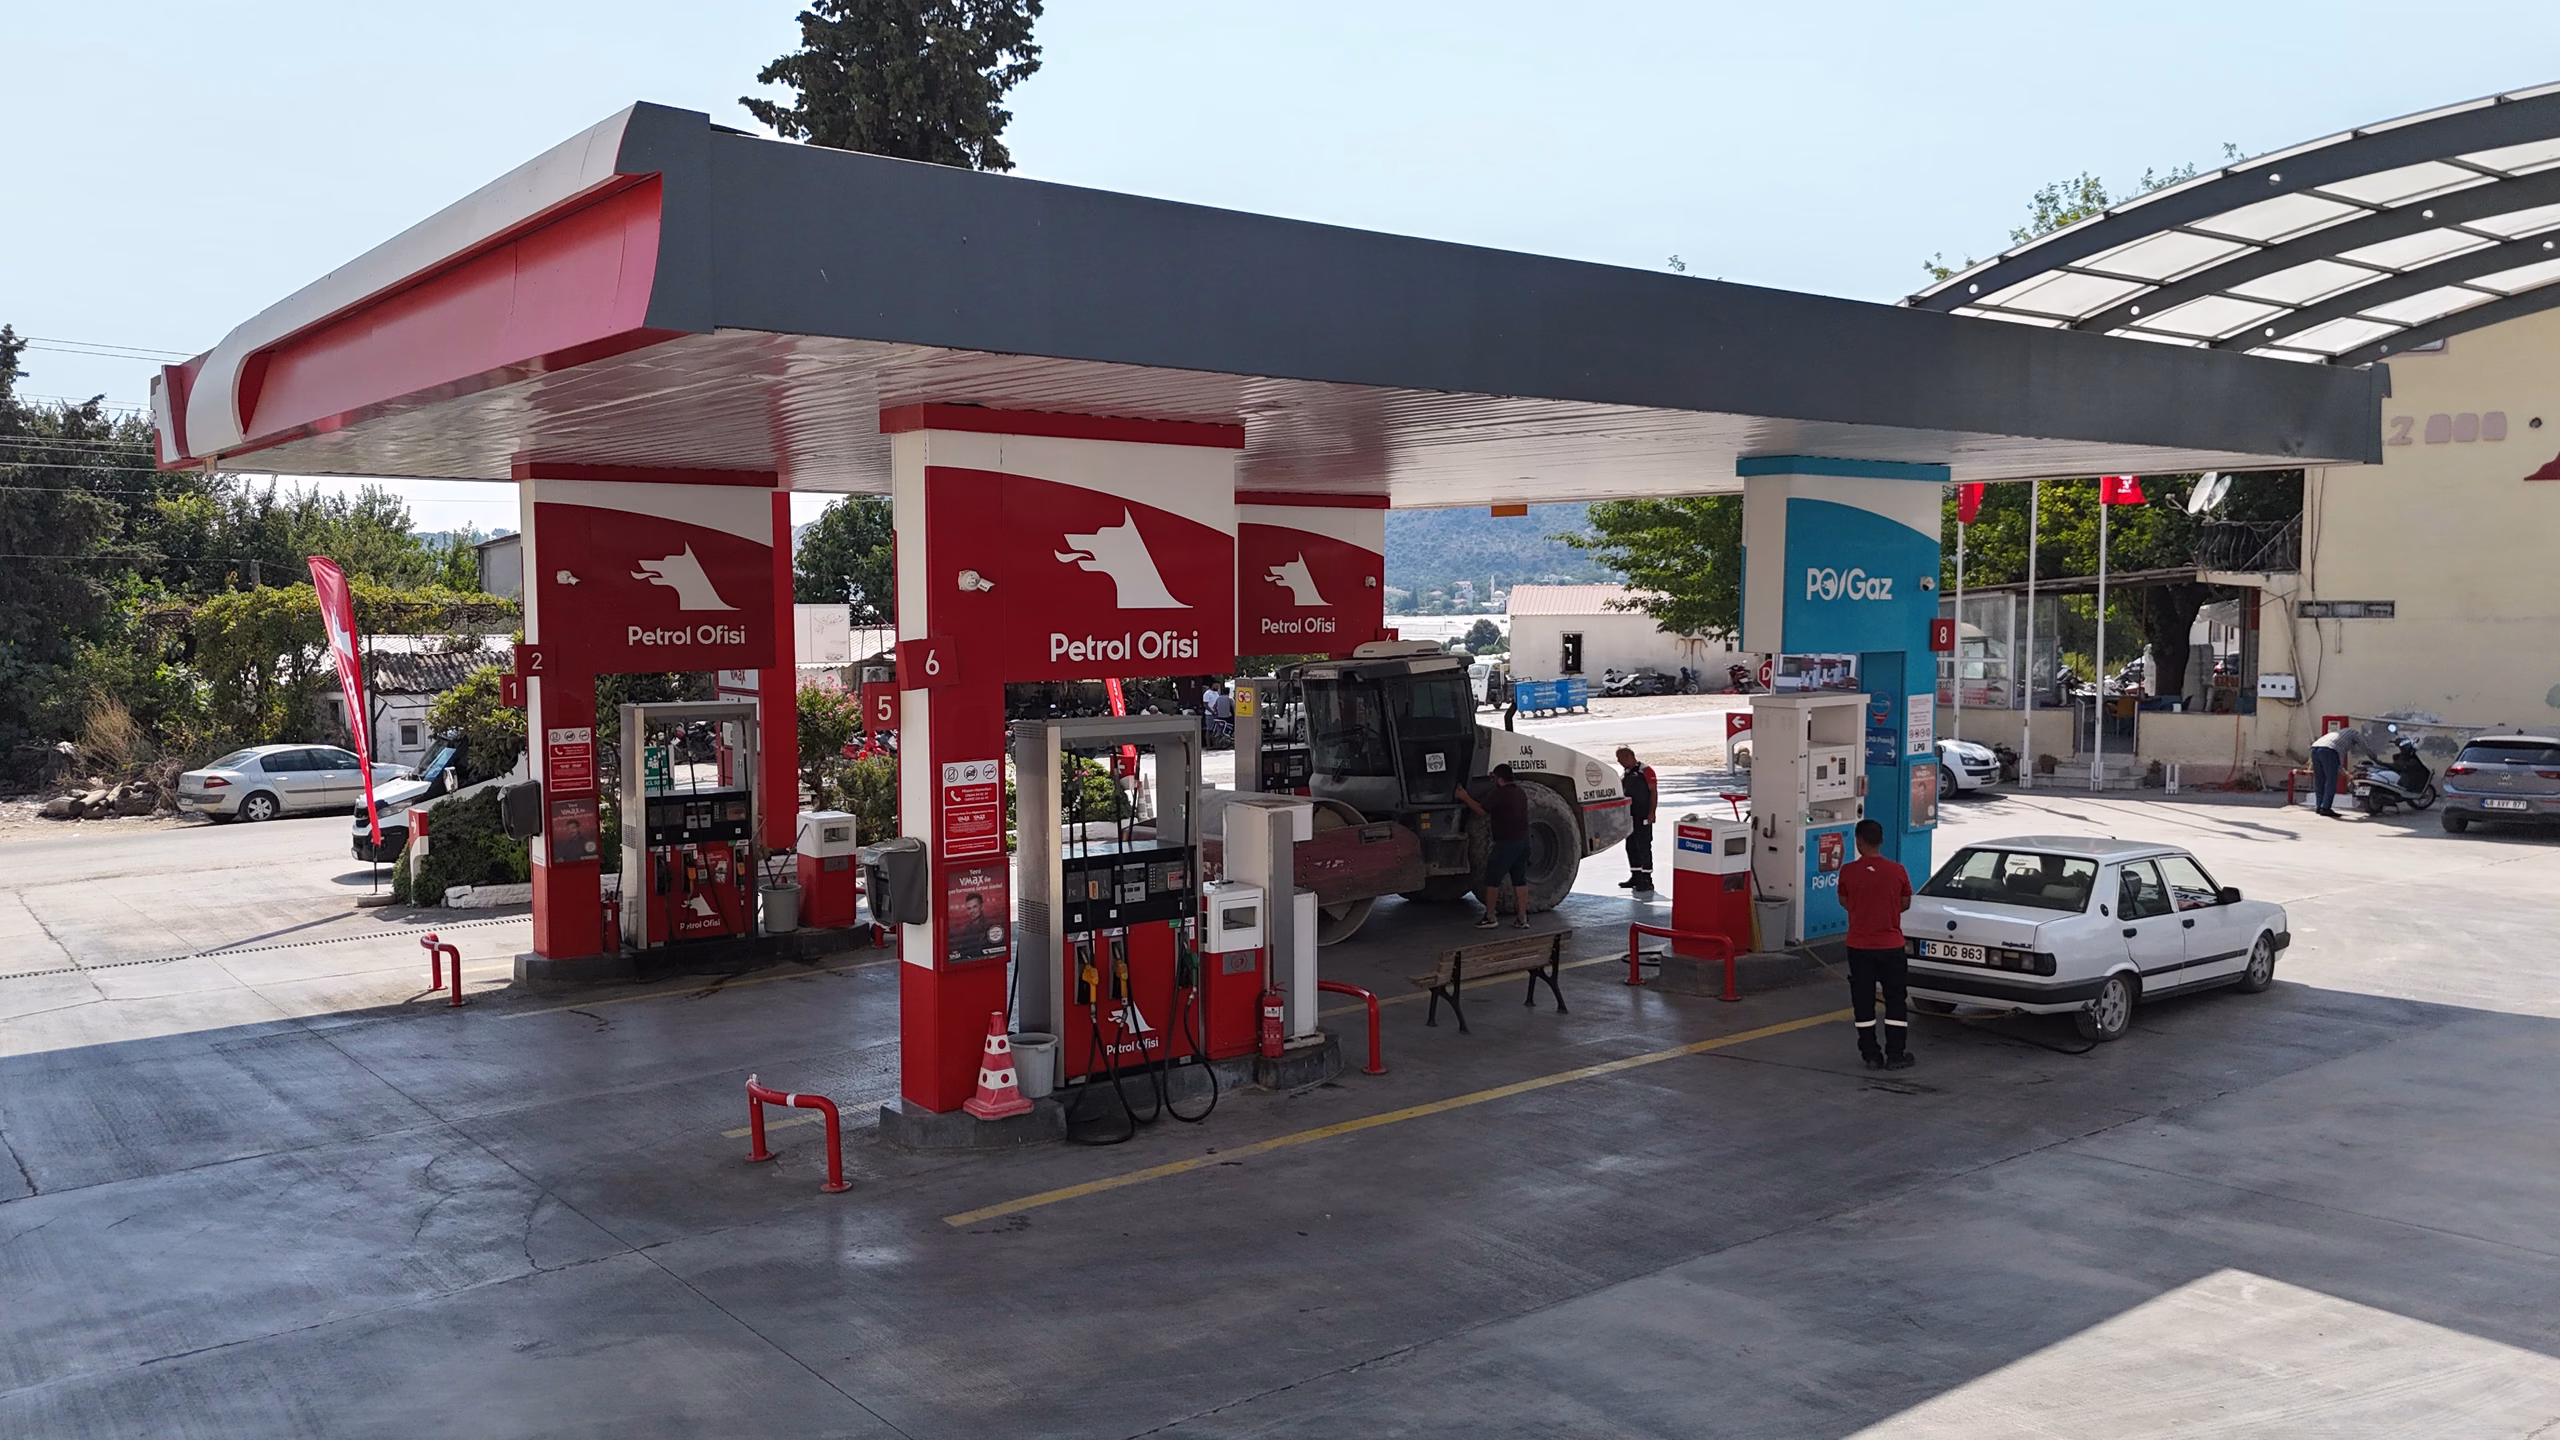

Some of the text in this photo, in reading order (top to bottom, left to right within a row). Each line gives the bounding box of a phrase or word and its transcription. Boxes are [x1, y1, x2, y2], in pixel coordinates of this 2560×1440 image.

[1261, 617, 1336, 634] Petrol Ofisi
[627, 625, 746, 646] Petrol Ofisi
[1939, 626, 1947, 644] 8
[1050, 630, 1198, 662] Petrol Ofisi
[531, 652, 543, 670] 2
[925, 649, 940, 676] 6
[509, 682, 517, 700] 1
[877, 695, 892, 721] 5
[1914, 743, 1925, 752] LPG
[1926, 941, 1983, 960] 15 DG 863
